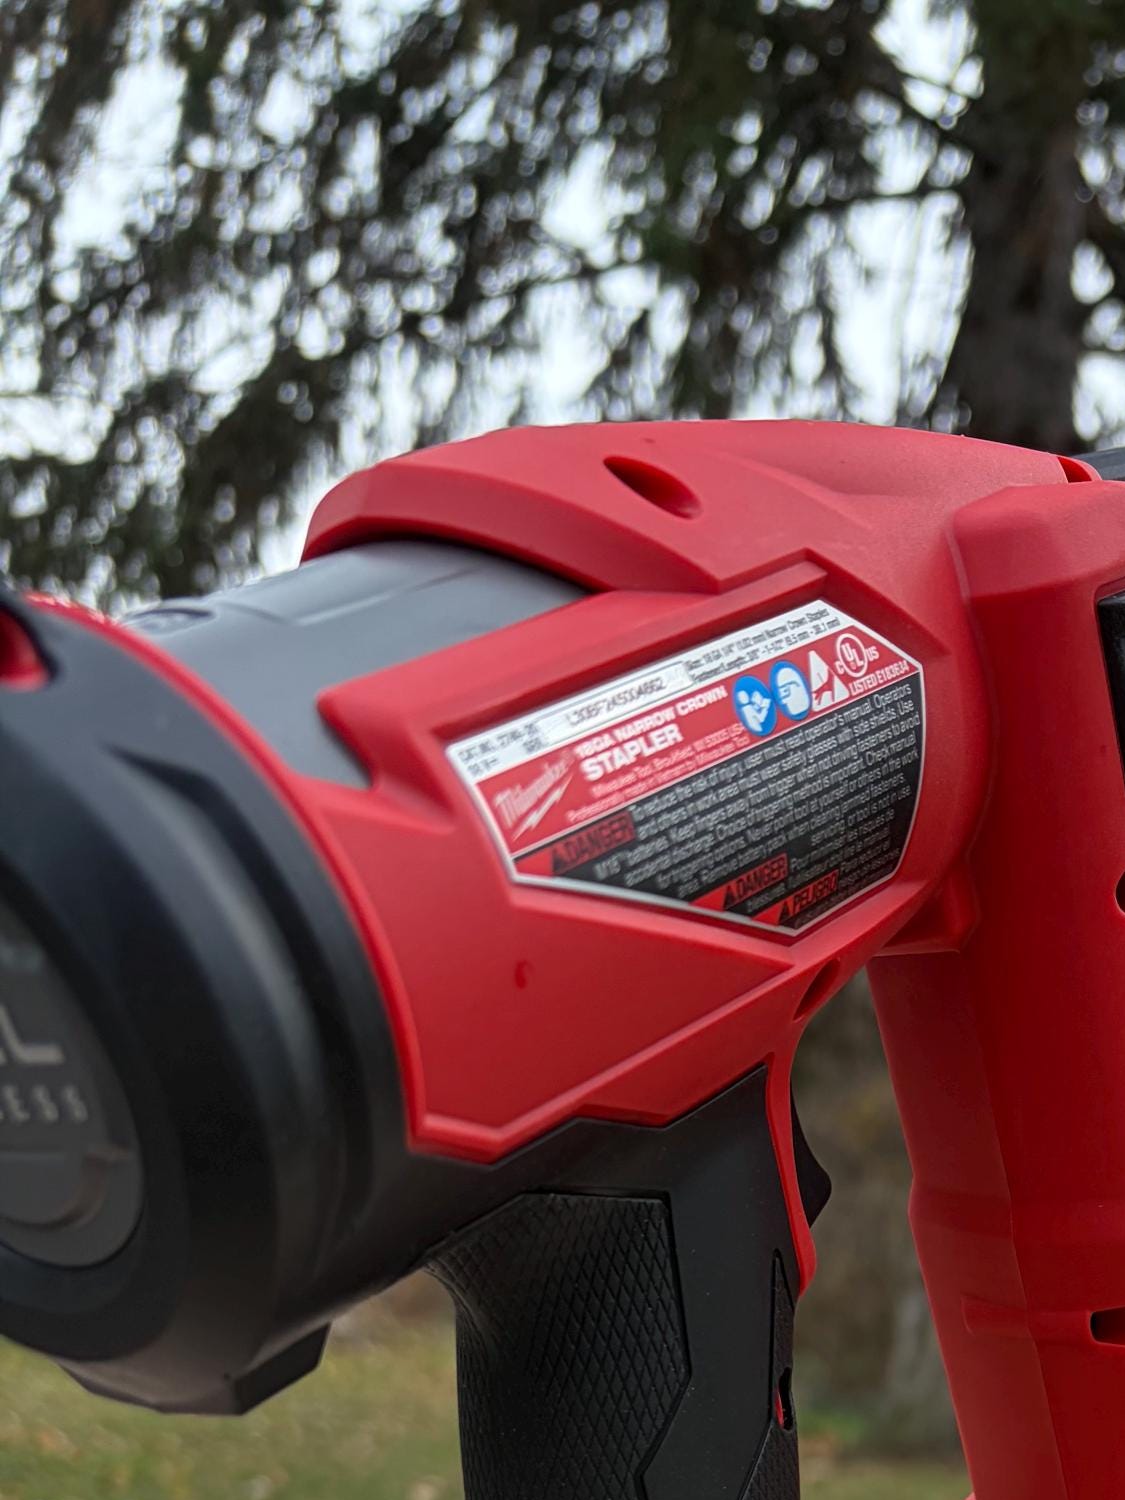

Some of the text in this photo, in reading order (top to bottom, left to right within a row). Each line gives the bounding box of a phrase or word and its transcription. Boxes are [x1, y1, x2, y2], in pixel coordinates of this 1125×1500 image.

[849, 674, 876, 694] LISTED
[575, 733, 614, 758] 18GA
[614, 706, 676, 742] NARROW
[675, 685, 728, 716] CROWN
[580, 721, 684, 782] STAPLER
[643, 791, 677, 816] reduce
[744, 751, 764, 769] user
[764, 739, 785, 760] must
[785, 730, 803, 750] read
[873, 683, 911, 709] Operators
[657, 807, 687, 830] others
[696, 790, 717, 811] work
[717, 783, 738, 801] area
[781, 750, 806, 771] safety
[807, 736, 837, 761] glasses
[854, 720, 869, 736] side
[897, 699, 914, 715] Use
[670, 822, 696, 844] Keep
[695, 807, 726, 831] fingers
[726, 797, 750, 817] away
[748, 788, 768, 806] from
[768, 774, 796, 796] trigger
[796, 764, 818, 782] when
[831, 745, 857, 765] driving
[857, 729, 892, 753] fasteners
[900, 713, 920, 732] avoid
[715, 817, 746, 841] Choice
[793, 777, 822, 803] method
[865, 743, 889, 766] Check
[890, 730, 916, 754] manual
[747, 824, 772, 844] Never
[774, 811, 794, 832] point
[794, 803, 810, 819] tool
[819, 783, 849, 809] yourself
[857, 769, 881, 787] others
[901, 748, 918, 765] work
[565, 812, 632, 864] DANGER
[788, 822, 809, 841] when
[810, 806, 840, 829] clearing
[841, 789, 870, 815] jammed
[737, 855, 786, 900] DANGER
[795, 869, 837, 914] PELIGRO
